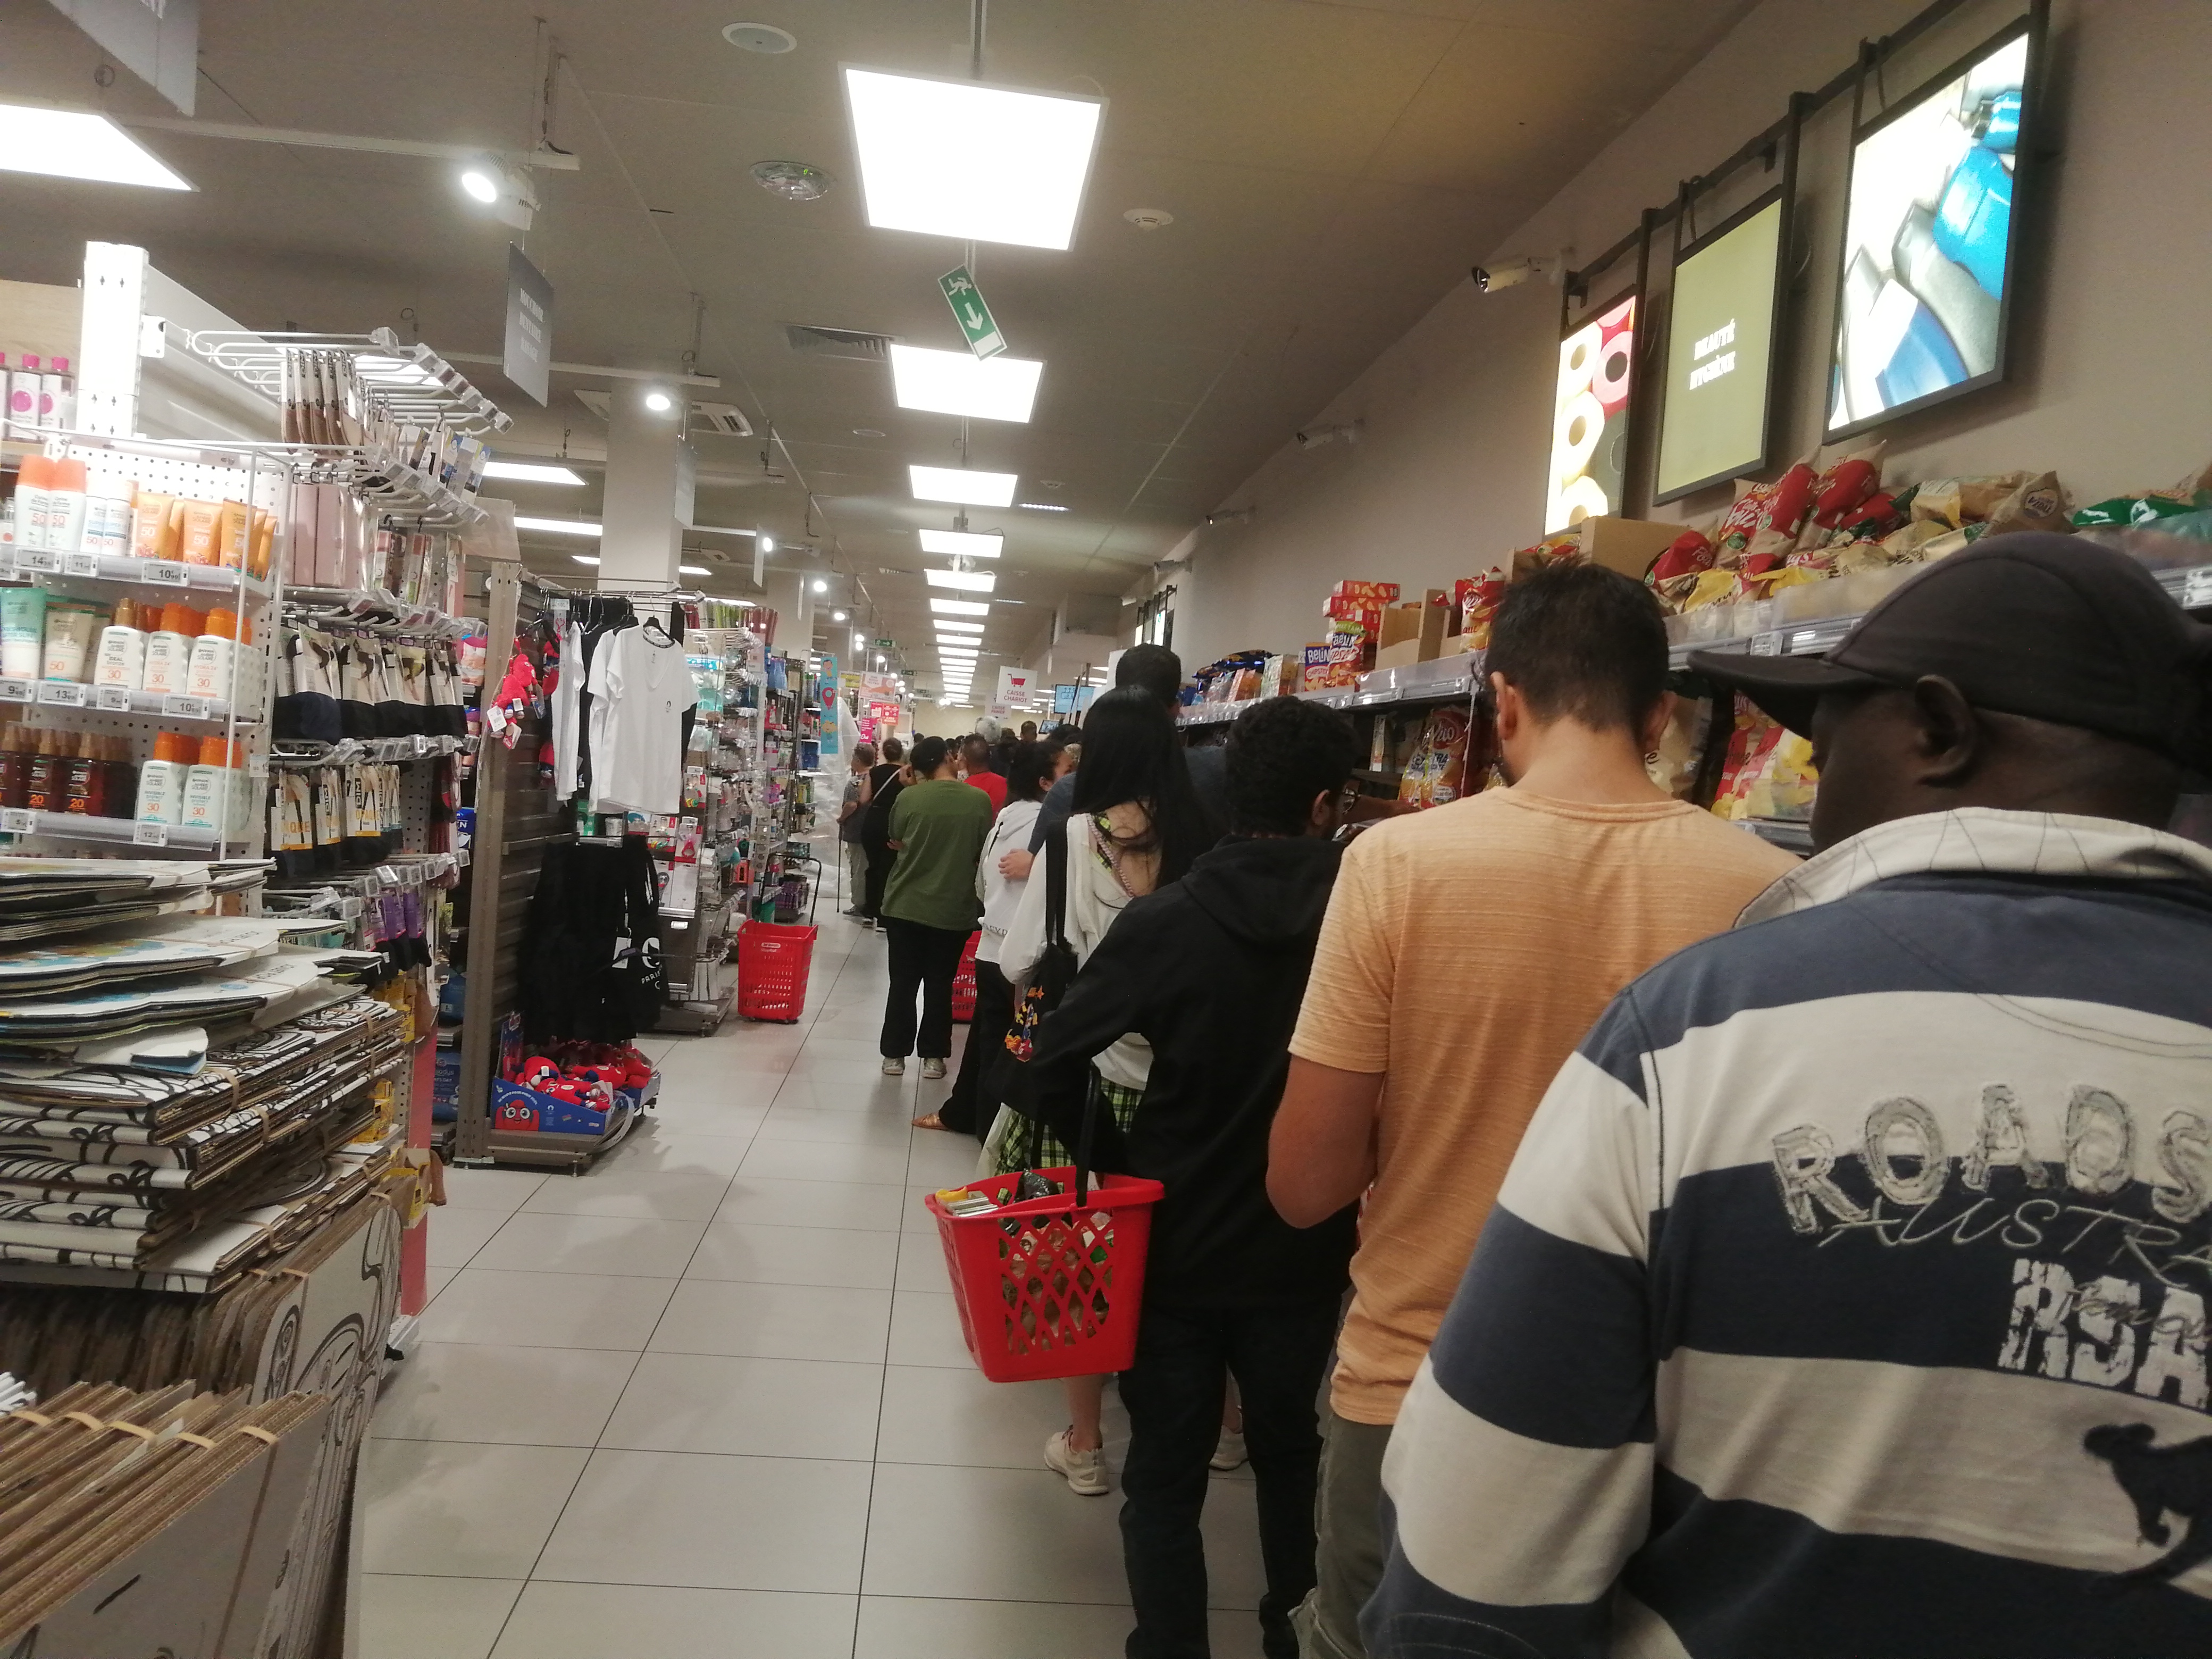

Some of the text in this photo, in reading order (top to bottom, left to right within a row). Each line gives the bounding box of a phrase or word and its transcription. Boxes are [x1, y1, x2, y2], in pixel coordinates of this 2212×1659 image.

[140, 527, 155, 537] 50
[193, 535, 210, 546] 50
[49, 661, 64, 671] 50
[107, 669, 121, 679] 30
[152, 674, 164, 683] 30
[197, 677, 210, 688] 30
[30, 794, 45, 803] 20
[70, 798, 85, 808] 20
[147, 802, 160, 811] 30
[192, 807, 205, 816] 30
